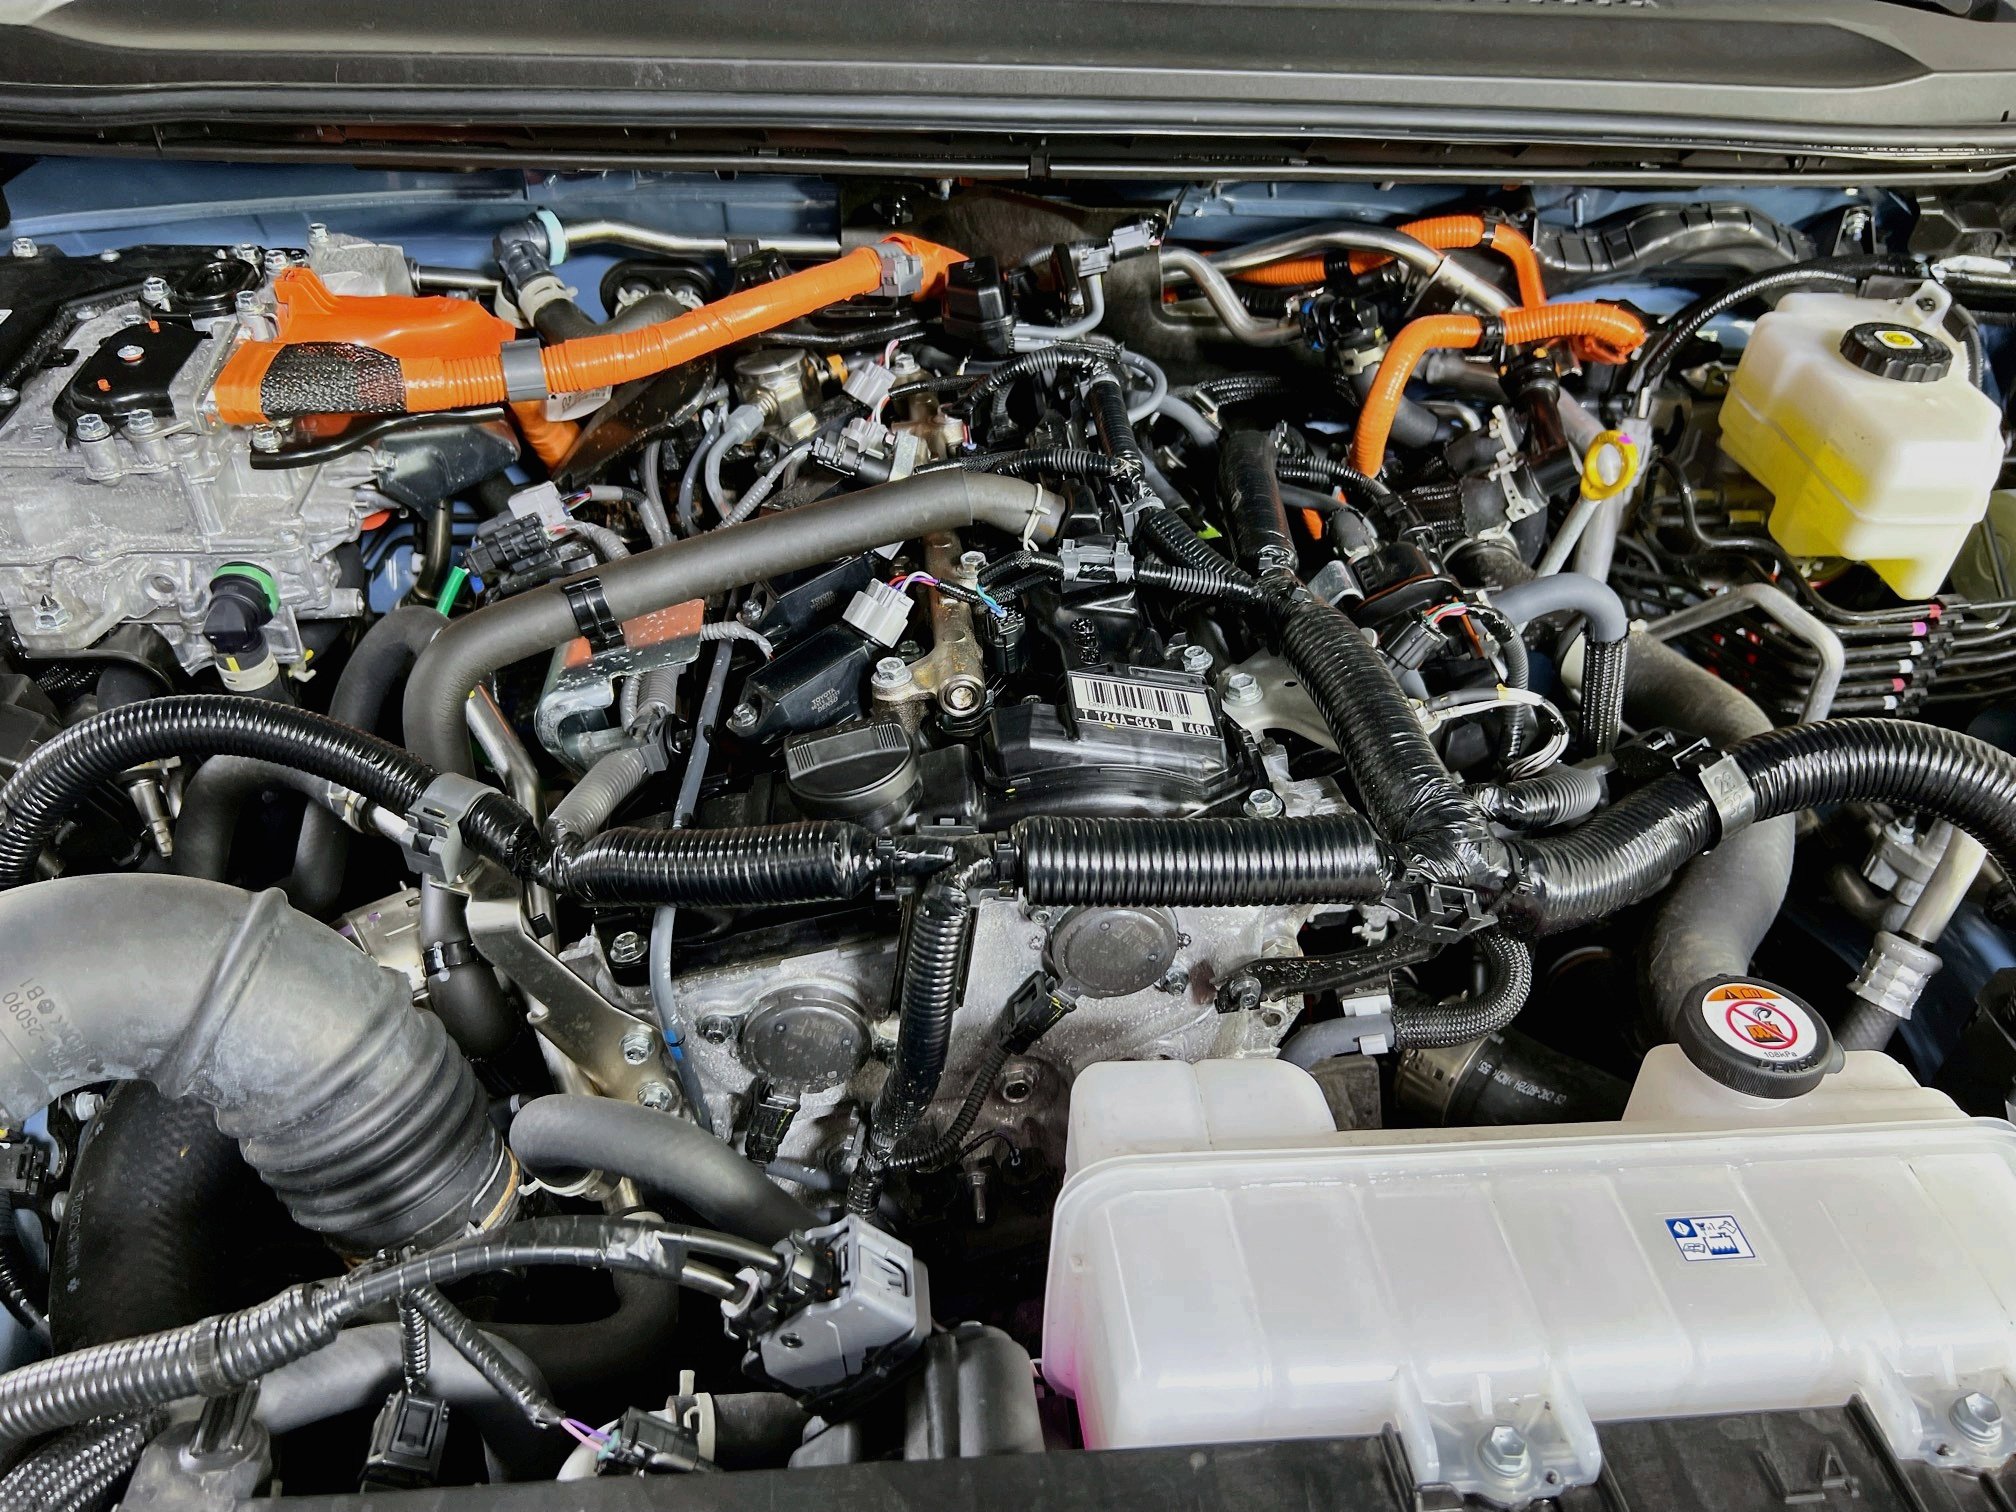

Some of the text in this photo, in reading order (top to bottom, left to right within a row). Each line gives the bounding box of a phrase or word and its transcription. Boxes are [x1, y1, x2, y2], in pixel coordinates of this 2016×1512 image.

[811, 688, 836, 704] TOYOTA
[1095, 711, 1160, 729] T24A-G43
[1188, 723, 1211, 736] 460
[1763, 1051, 1798, 1059] 108kPa
